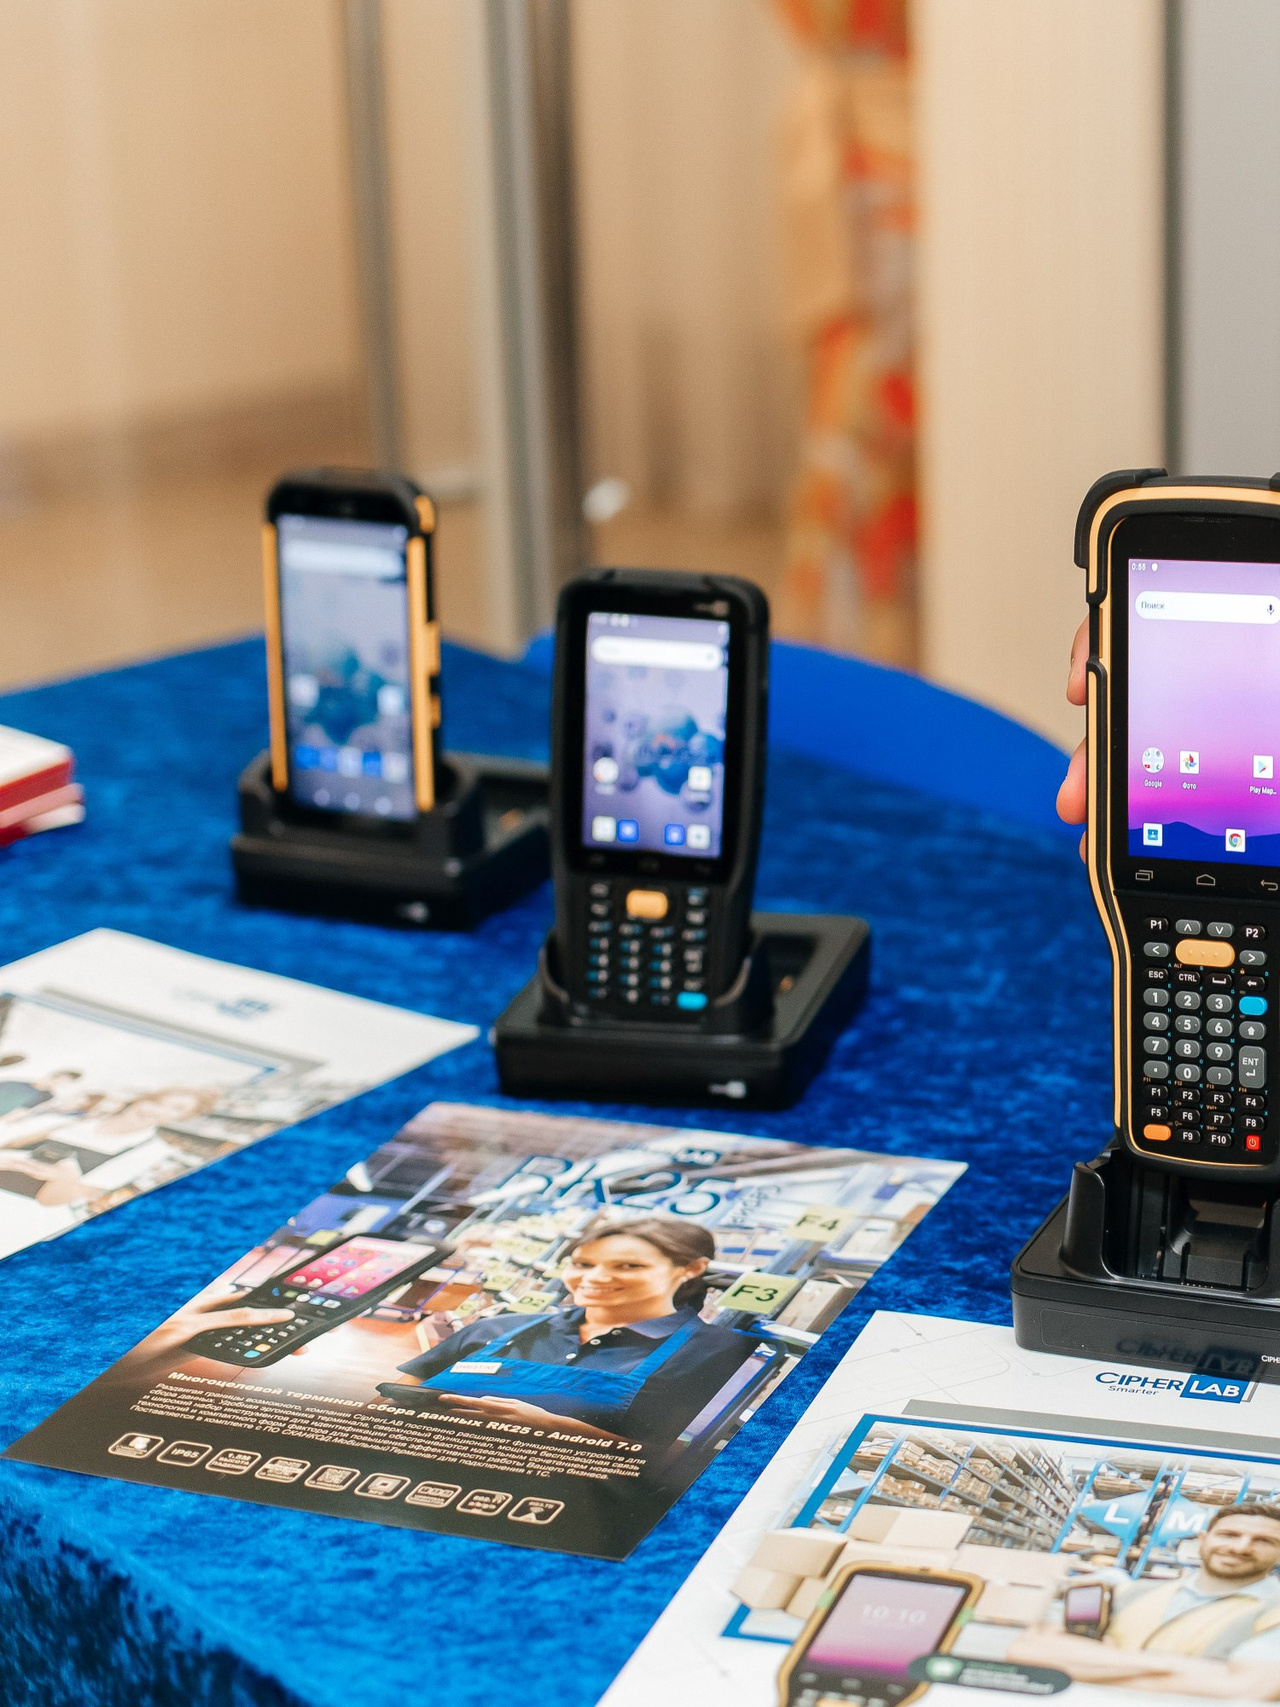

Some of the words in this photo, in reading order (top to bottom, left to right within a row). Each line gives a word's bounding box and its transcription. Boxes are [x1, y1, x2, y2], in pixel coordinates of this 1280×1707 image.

[1144, 779, 1162, 788] Google
[1249, 786, 1261, 794] Play
[1150, 920, 1162, 930] P1
[1246, 928, 1259, 938] P2
[1179, 974, 1197, 982] CTRL
[1153, 992, 1157, 1003] 1
[1184, 995, 1192, 1006] 2
[1215, 998, 1223, 1009] 3
[1152, 1017, 1160, 1027] 4
[1184, 1019, 1191, 1030] 5
[1215, 1022, 1223, 1034] 6
[1152, 1040, 1160, 1051] 7
[1184, 1044, 1191, 1054] 8
[1215, 1047, 1223, 1057] 9
[1242, 1057, 1259, 1066] ENT
[1184, 1068, 1191, 1079] 0
[1151, 1088, 1161, 1097] F1
[1183, 1091, 1193, 1100] F2
[1214, 1094, 1224, 1103] F3
[1246, 1098, 1256, 1106] F4
[1151, 1108, 1161, 1117] F5
[1183, 1112, 1193, 1121] F6
[1214, 1115, 1224, 1124] F7
[1246, 1119, 1256, 1127] F8
[1183, 1132, 1193, 1141] F9
[1212, 1135, 1226, 1144] F10
[494, 1154, 738, 1215] RK25
[795, 1213, 840, 1232] F4
[731, 1284, 779, 1302] F3
[1107, 1385, 1160, 1396] Smarter
[168, 1372, 282, 1394] Многоцелевой
[287, 1391, 364, 1408] терминал
[367, 1404, 416, 1416] сбора
[417, 1412, 483, 1427] данных
[486, 1421, 532, 1434] RK25
[547, 1431, 613, 1447] Android
[616, 1441, 643, 1452] 7.0
[155, 1383, 204, 1395] Раздвигая
[204, 1391, 245, 1401] границы
[305, 1407, 352, 1418] компания
[353, 1413, 404, 1426] CipherLAB
[404, 1423, 456, 1435] постоянно
[456, 1431, 511, 1444] расширяет
[512, 1440, 573, 1454] функционал
[574, 1450, 625, 1462] устройств
[149, 1389, 178, 1398] сбора
[218, 1399, 259, 1410] Удобная
[260, 1406, 315, 1419] эргономика
[497, 1445, 538, 1455] мощная
[539, 1450, 610, 1466] беспроводная
[611, 1462, 640, 1471] связь
[129, 1404, 195, 1420] Поставляется
[203, 1417, 254, 1429] комплекте
[262, 1425, 281, 1433] ПО
[436, 1455, 458, 1463] для
[458, 1459, 525, 1473] подключения
[137, 1400, 190, 1412] технологий
[198, 1410, 257, 1423] компактного
[258, 1419, 287, 1427] форм
[287, 1423, 329, 1435] фактора
[328, 1430, 350, 1438] для
[350, 1434, 407, 1447] повышения
[408, 1444, 486, 1460] эффективности
[486, 1457, 525, 1467] работы
[526, 1462, 565, 1473] Вашего
[150, 1396, 193, 1406] широкий
[193, 1403, 223, 1411] набор
[223, 1407, 290, 1421] инструментов
[289, 1417, 310, 1425] для
[310, 1421, 387, 1437] идентификации
[528, 1456, 588, 1469] сочетанием
[589, 1466, 640, 1477] новейших
[171, 1448, 200, 1458] IP65
[1104, 1503, 1130, 1525] L
[1165, 1510, 1206, 1532] M
